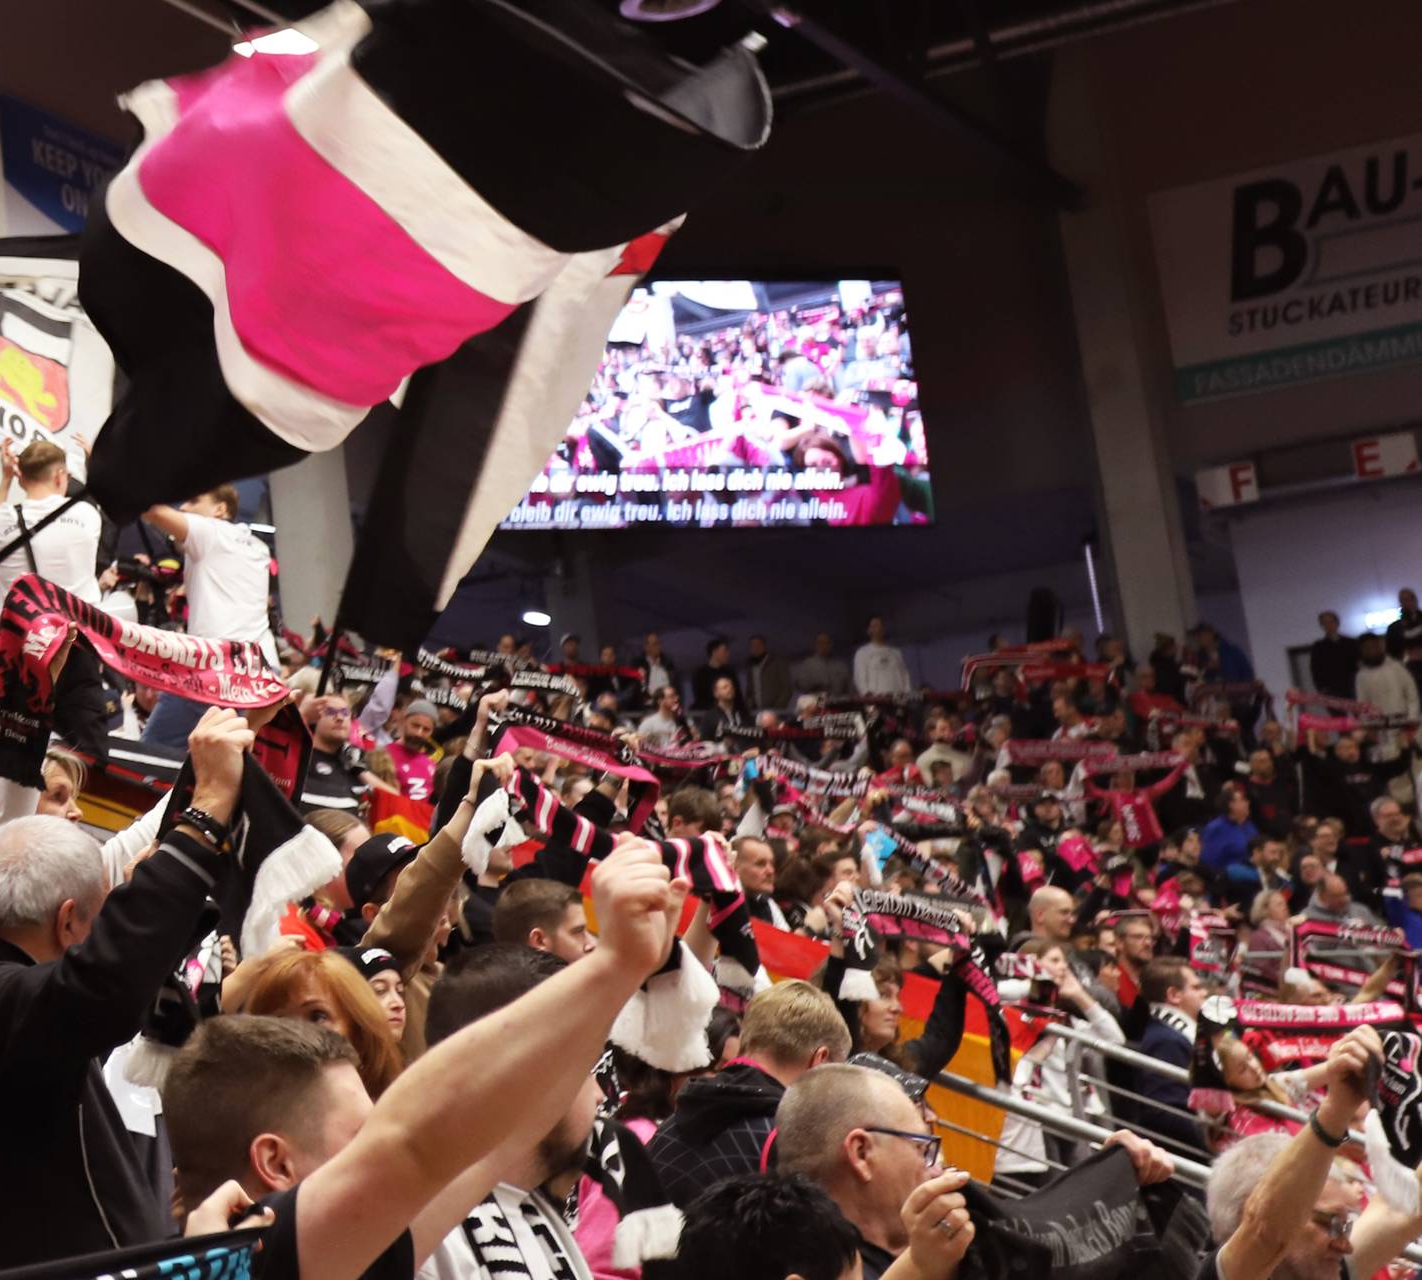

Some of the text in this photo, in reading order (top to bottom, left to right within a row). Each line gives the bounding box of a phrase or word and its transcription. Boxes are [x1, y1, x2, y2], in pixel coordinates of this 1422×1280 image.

[32, 137, 77, 179] KEEP
[1194, 333, 1422, 394] FASSADENDÄMM
[1353, 440, 1384, 479] E
[576, 470, 618, 496] ewig
[662, 468, 690, 492] Ich
[1229, 463, 1254, 500] F
[554, 501, 580, 522] dir
[580, 501, 621, 524] ewig
[624, 502, 663, 521] treu.
[666, 498, 693, 521] Ich
[695, 498, 729, 521] lass
[731, 498, 767, 521] dich
[770, 498, 797, 520] nie
[798, 497, 848, 520] allein.
